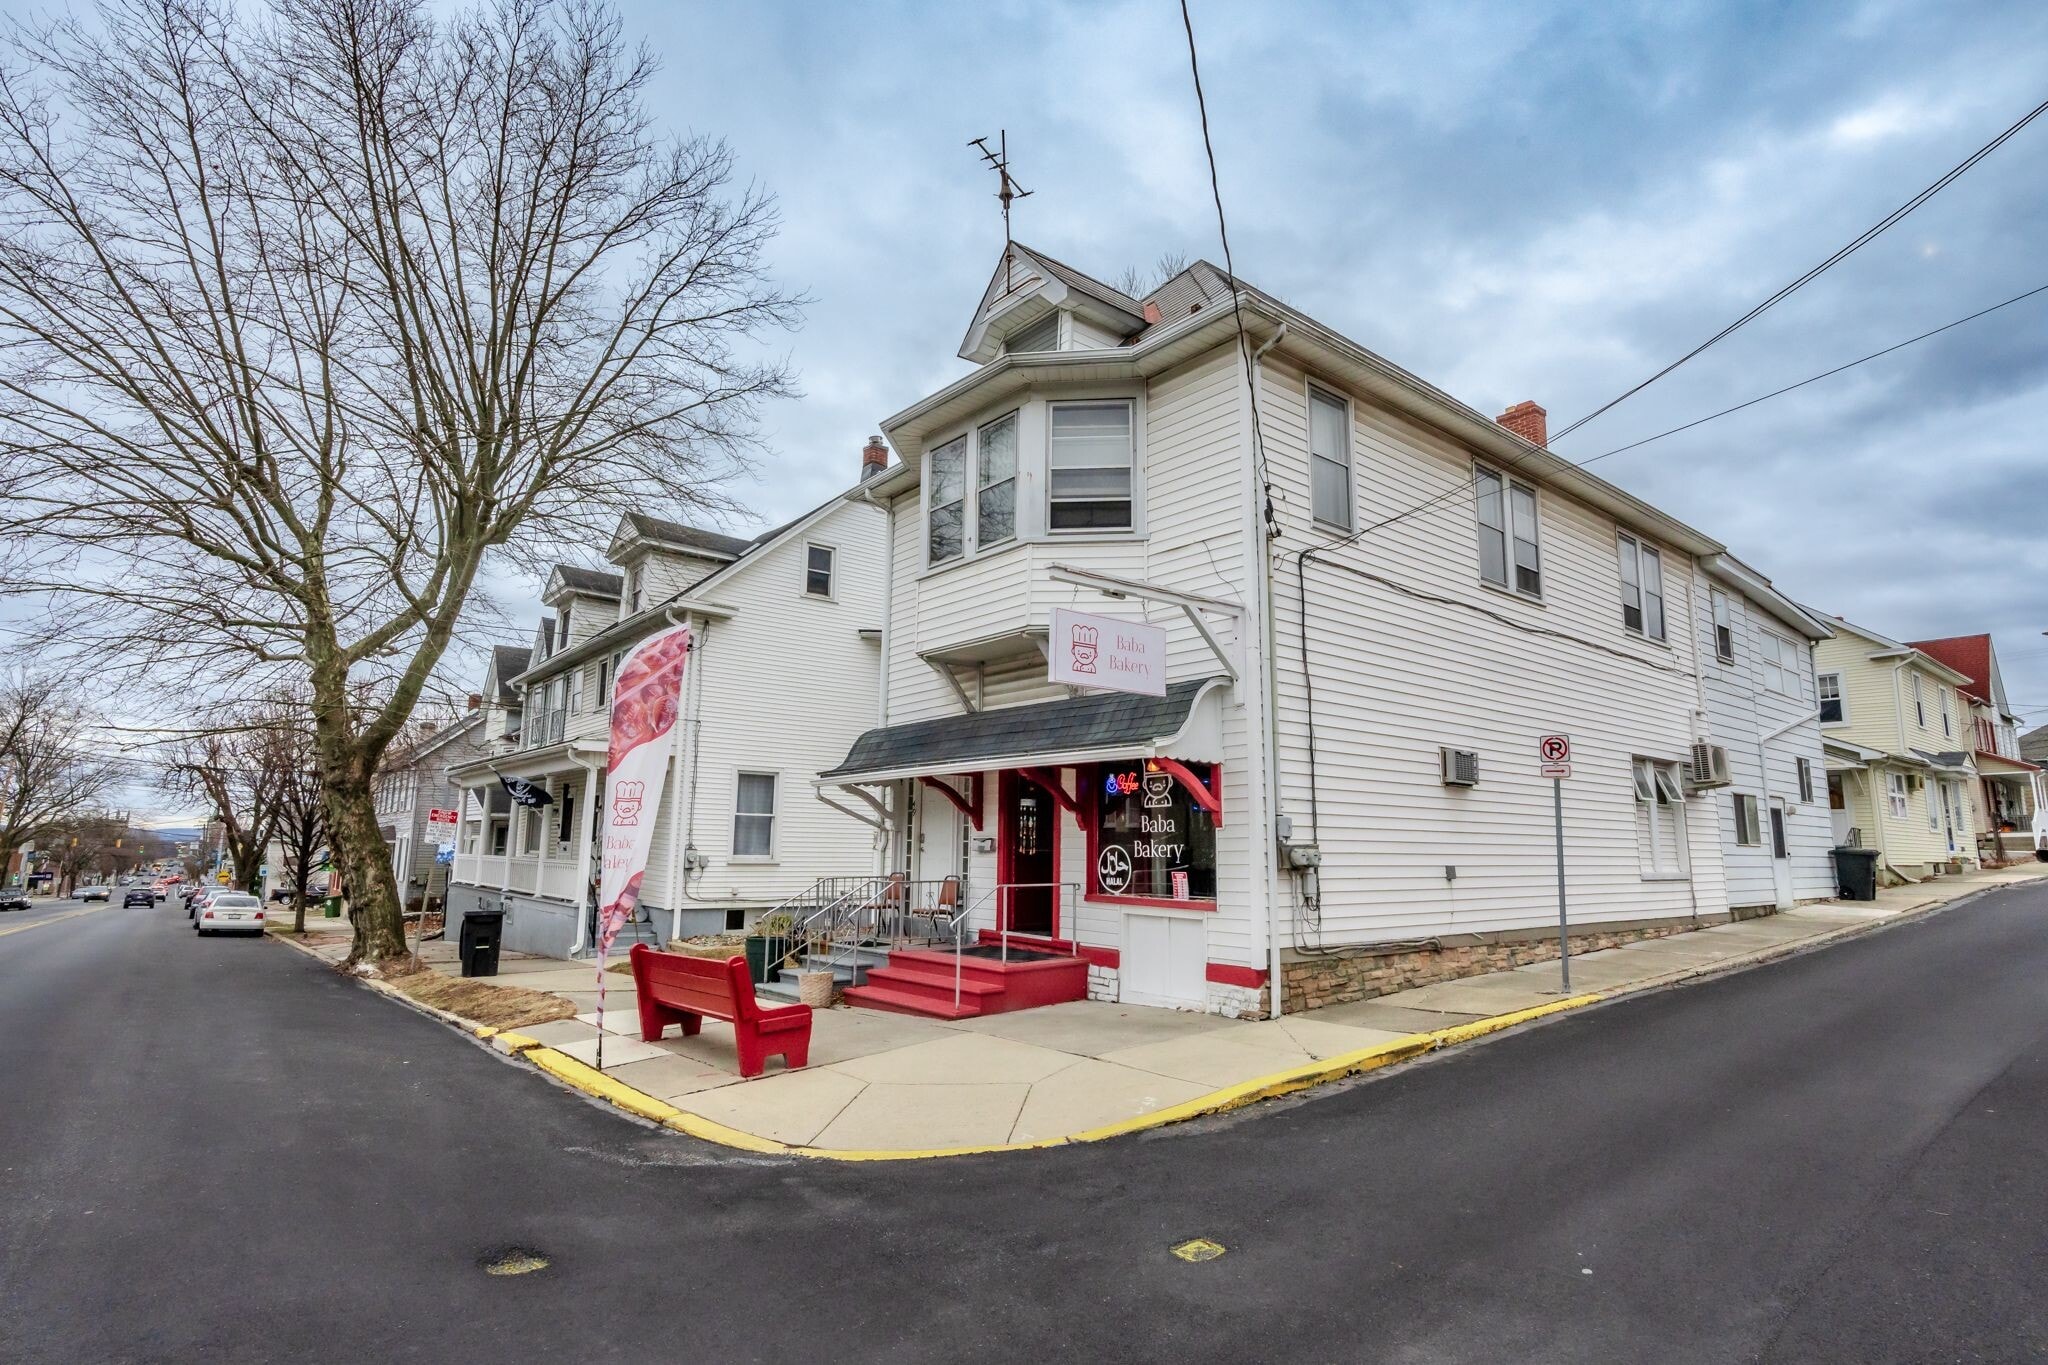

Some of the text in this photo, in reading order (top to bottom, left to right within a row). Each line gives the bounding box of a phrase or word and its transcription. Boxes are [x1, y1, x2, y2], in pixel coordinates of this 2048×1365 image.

[1117, 634, 1145, 654] Baba
[1109, 654, 1152, 680] Bakery
[1117, 772, 1139, 794] Coffee
[1141, 814, 1176, 833] Baba
[1133, 839, 1185, 864] Bakery
[1101, 851, 1129, 875] حلال
[1106, 877, 1123, 886] HALAL
